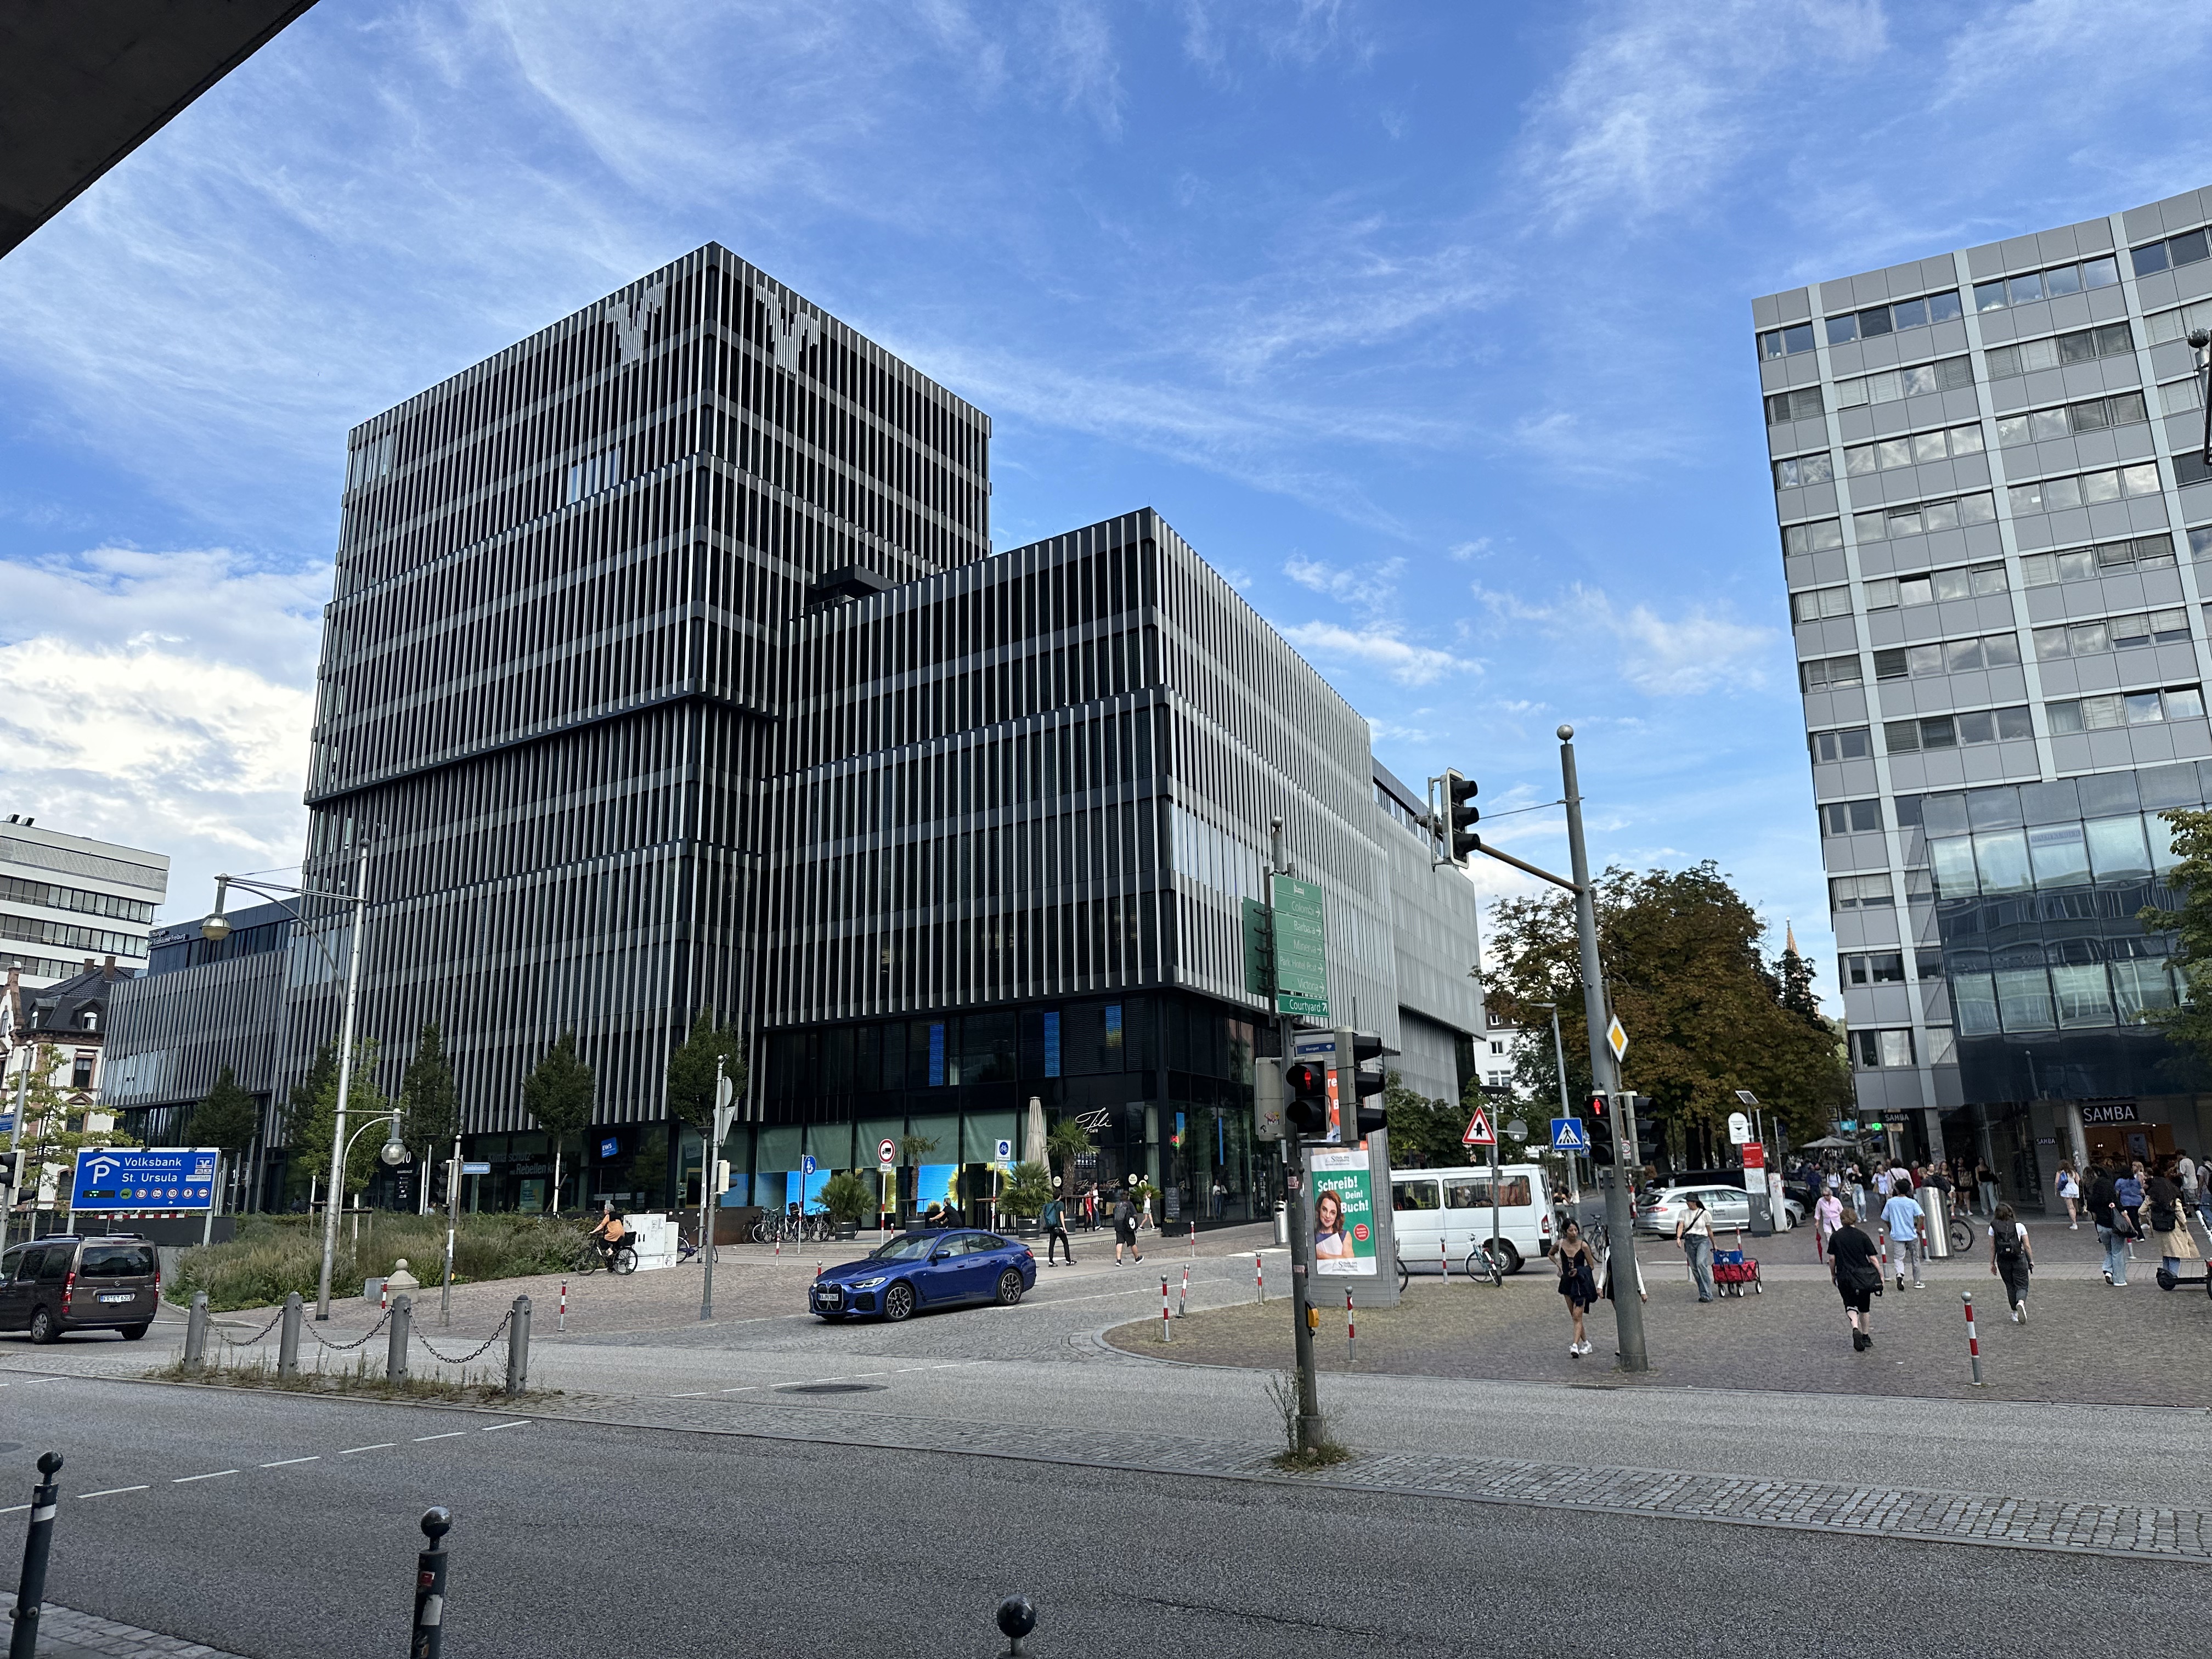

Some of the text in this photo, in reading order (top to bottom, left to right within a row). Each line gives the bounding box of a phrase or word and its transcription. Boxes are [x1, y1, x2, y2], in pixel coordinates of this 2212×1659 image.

[1291, 901, 1314, 916] Colombi
[1294, 920, 1316, 934] Barbara
[1293, 939, 1317, 953] Minerva
[1279, 956, 1317, 972] Park Hotel Post
[1297, 977, 1319, 991] Victoria
[1289, 999, 1321, 1014] Courtyard
[2083, 1105, 2135, 1122] SAMBA
[602, 1143, 612, 1151] EWS
[124, 1157, 182, 1167] Volksbank
[516, 1163, 546, 1175] Rebellen
[121, 1173, 178, 1182] St. Ursula
[1317, 1175, 1358, 1192] Schreib!
[1340, 1199, 1369, 1214] Buch!
